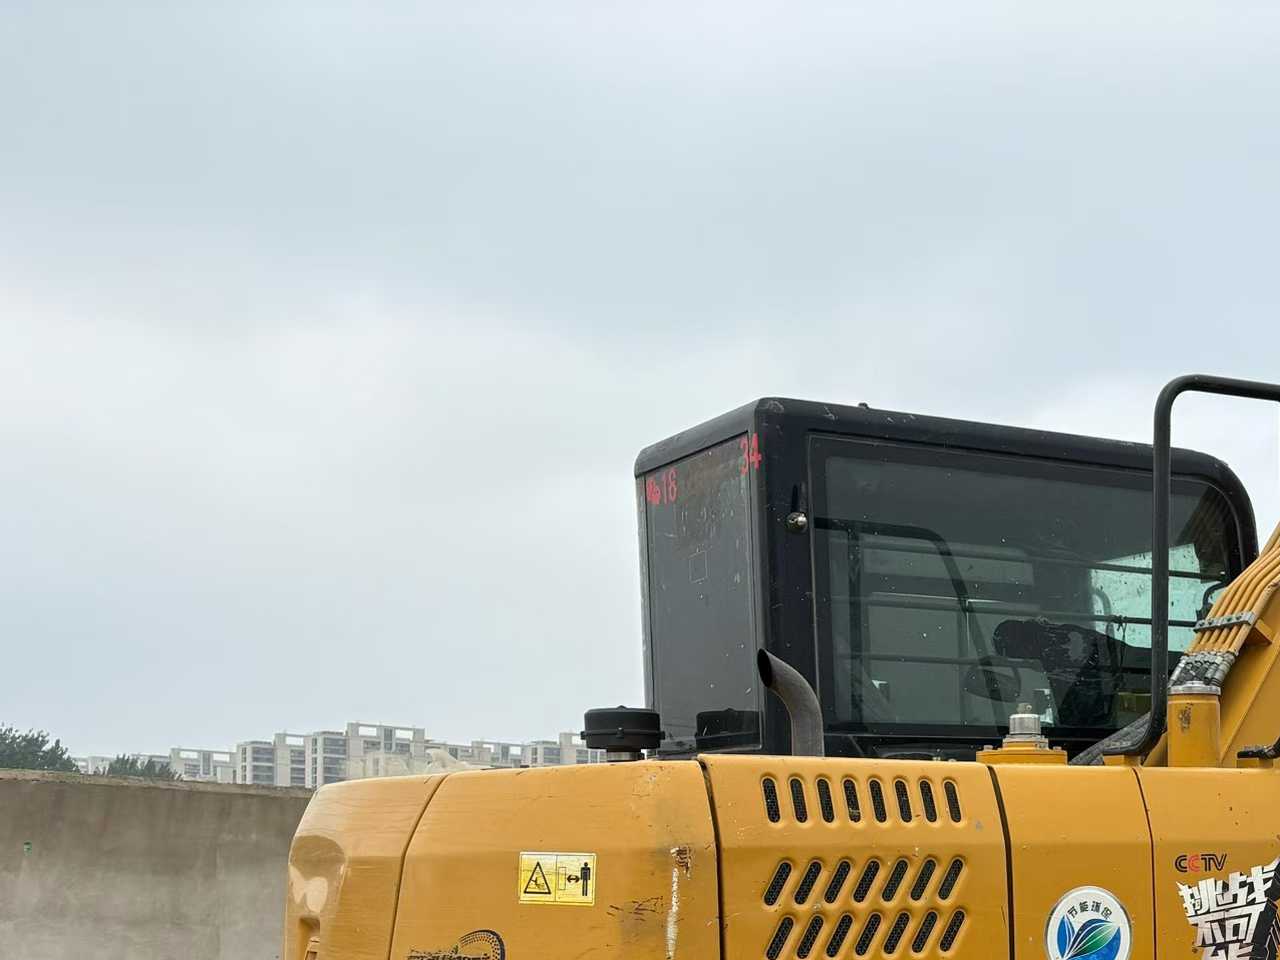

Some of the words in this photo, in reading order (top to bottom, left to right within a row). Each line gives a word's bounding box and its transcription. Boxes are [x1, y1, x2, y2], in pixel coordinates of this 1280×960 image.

[1175, 854, 1227, 872] CCTV
[1176, 856, 1280, 915] 挑战
[1188, 902, 1267, 946] 不可
